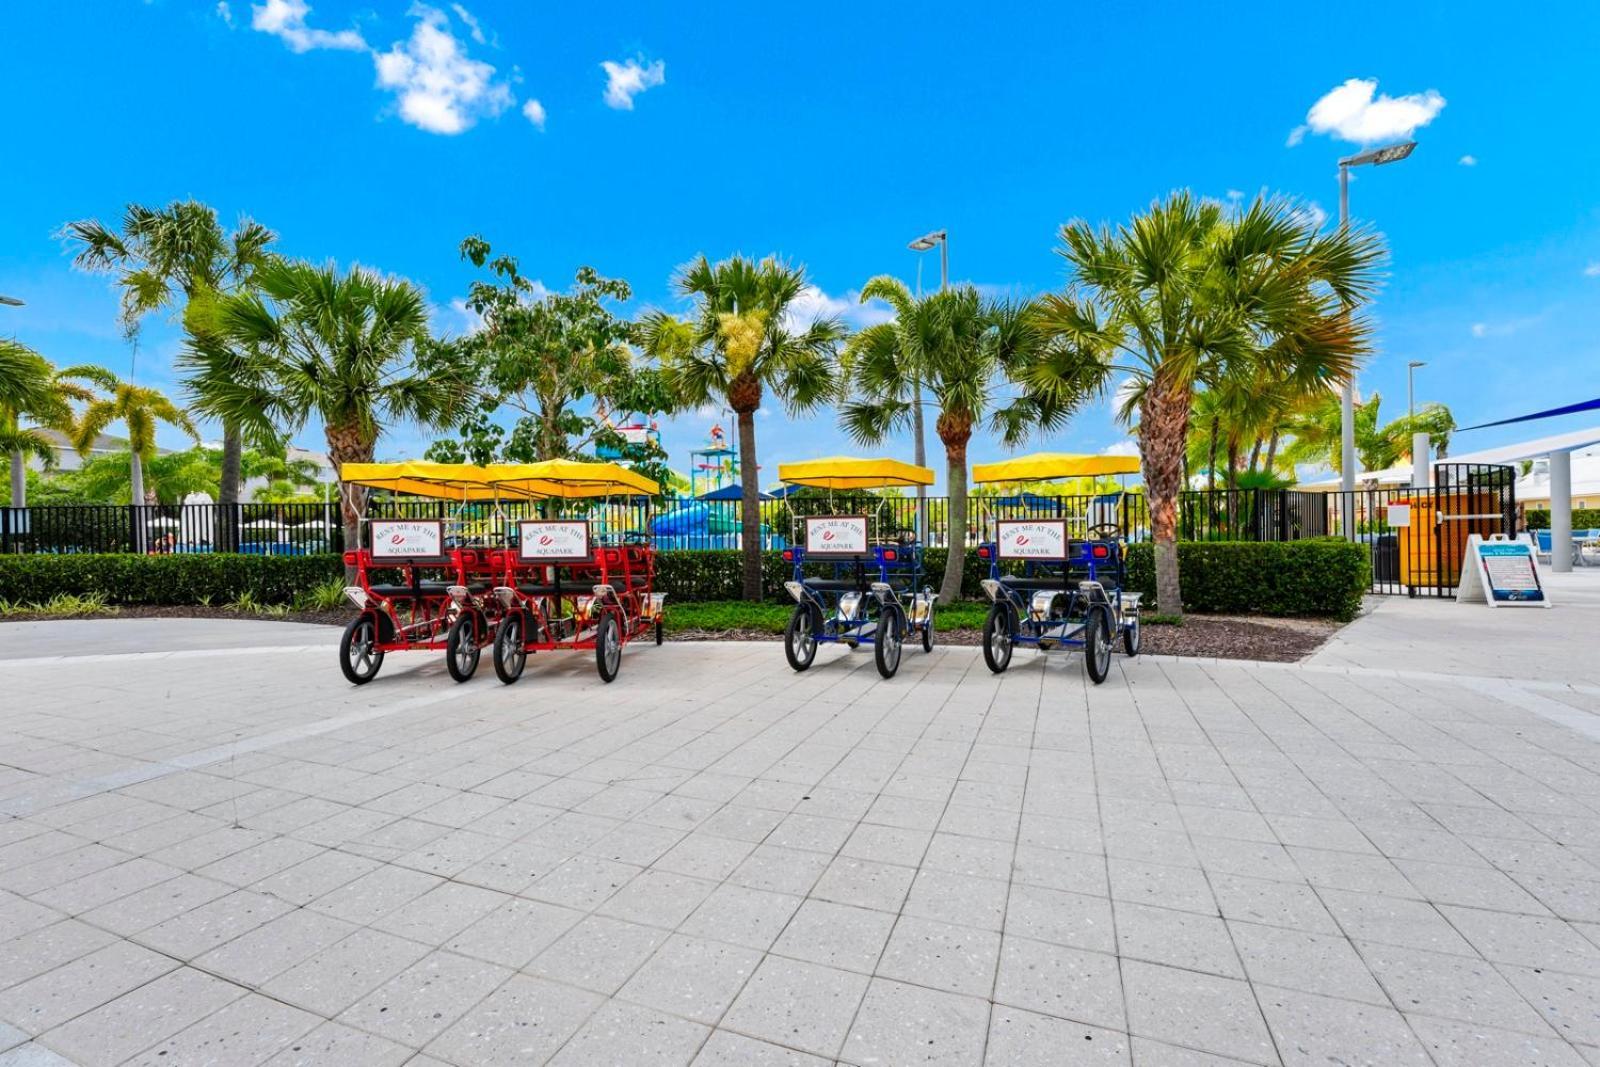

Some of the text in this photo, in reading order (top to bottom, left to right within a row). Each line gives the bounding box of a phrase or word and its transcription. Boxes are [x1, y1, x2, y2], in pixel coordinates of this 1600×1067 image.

[376, 526, 394, 540] RENT
[423, 527, 436, 539] THE
[525, 527, 543, 540] RENT
[570, 528, 584, 541] THE
[811, 522, 827, 536] RENT
[850, 524, 863, 536] THE
[1002, 527, 1020, 540] RENT
[1047, 528, 1061, 540] THE
